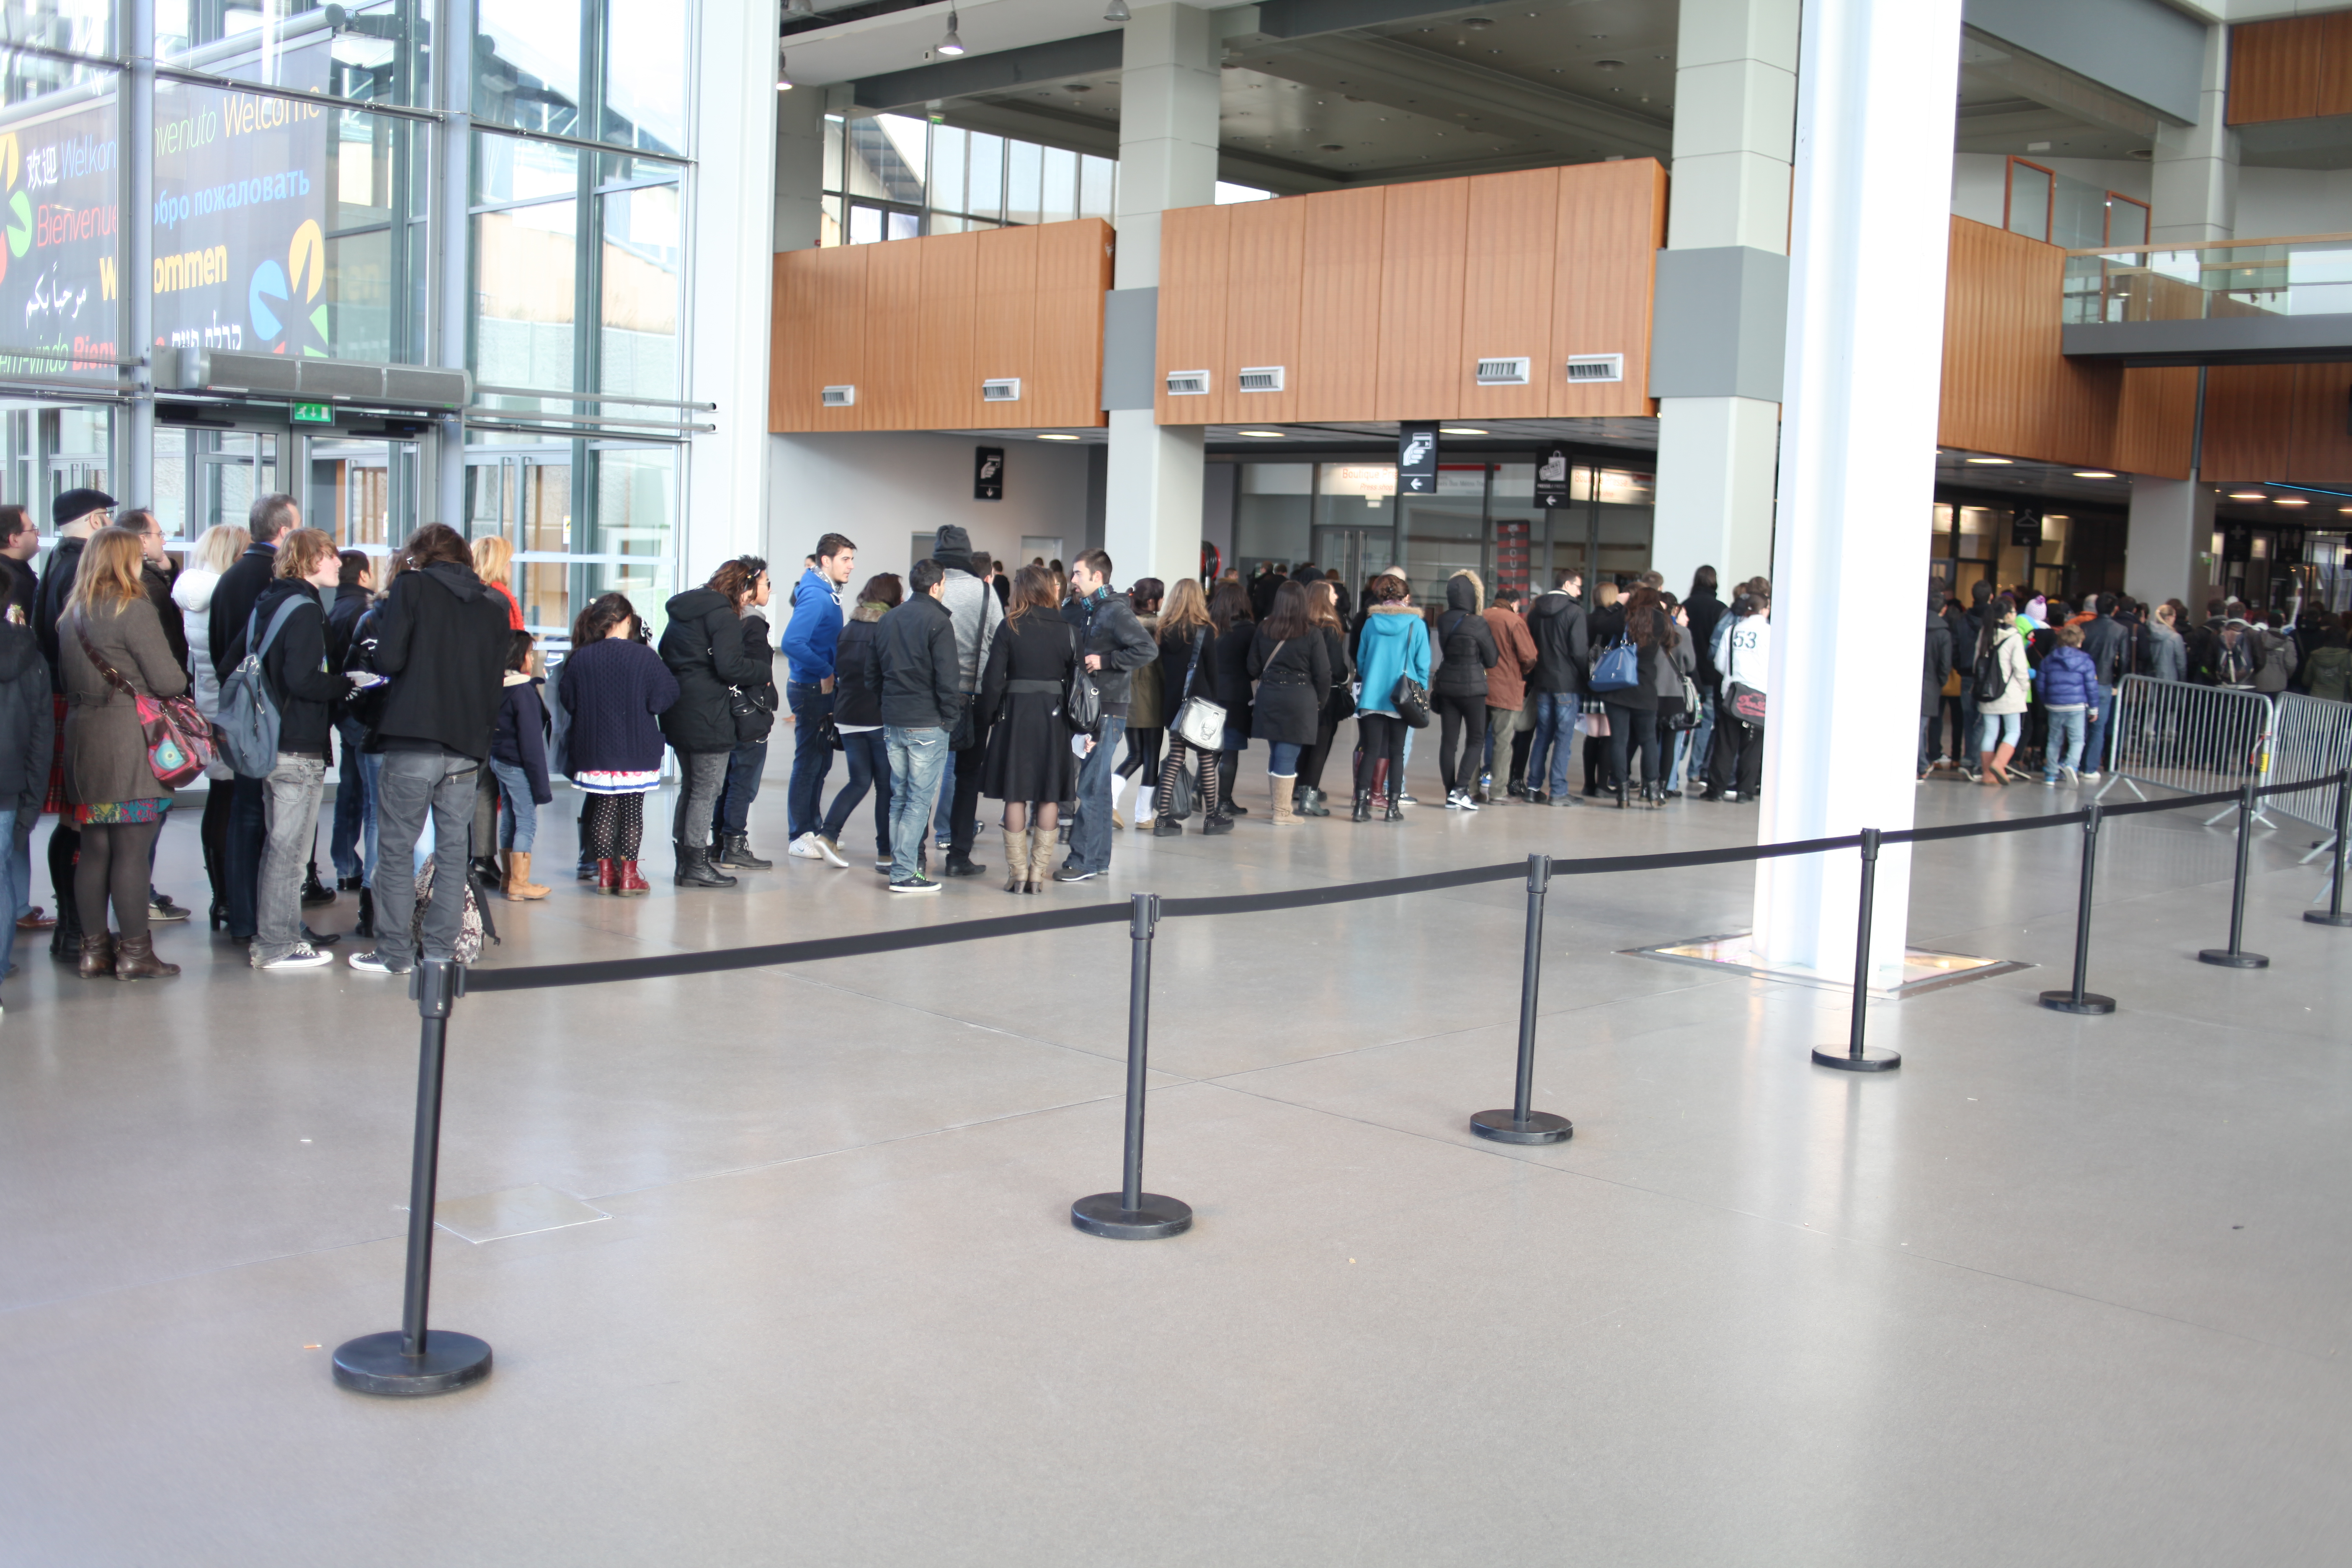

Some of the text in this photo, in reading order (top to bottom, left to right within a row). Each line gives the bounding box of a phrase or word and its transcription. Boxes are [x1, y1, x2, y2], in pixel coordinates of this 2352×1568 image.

[26, 146, 59, 189] 欢迎
[194, 170, 310, 216] пожаловать
[1342, 468, 1379, 481] Boutique
[1378, 483, 1393, 492] shop
[1732, 630, 1757, 649] 53
